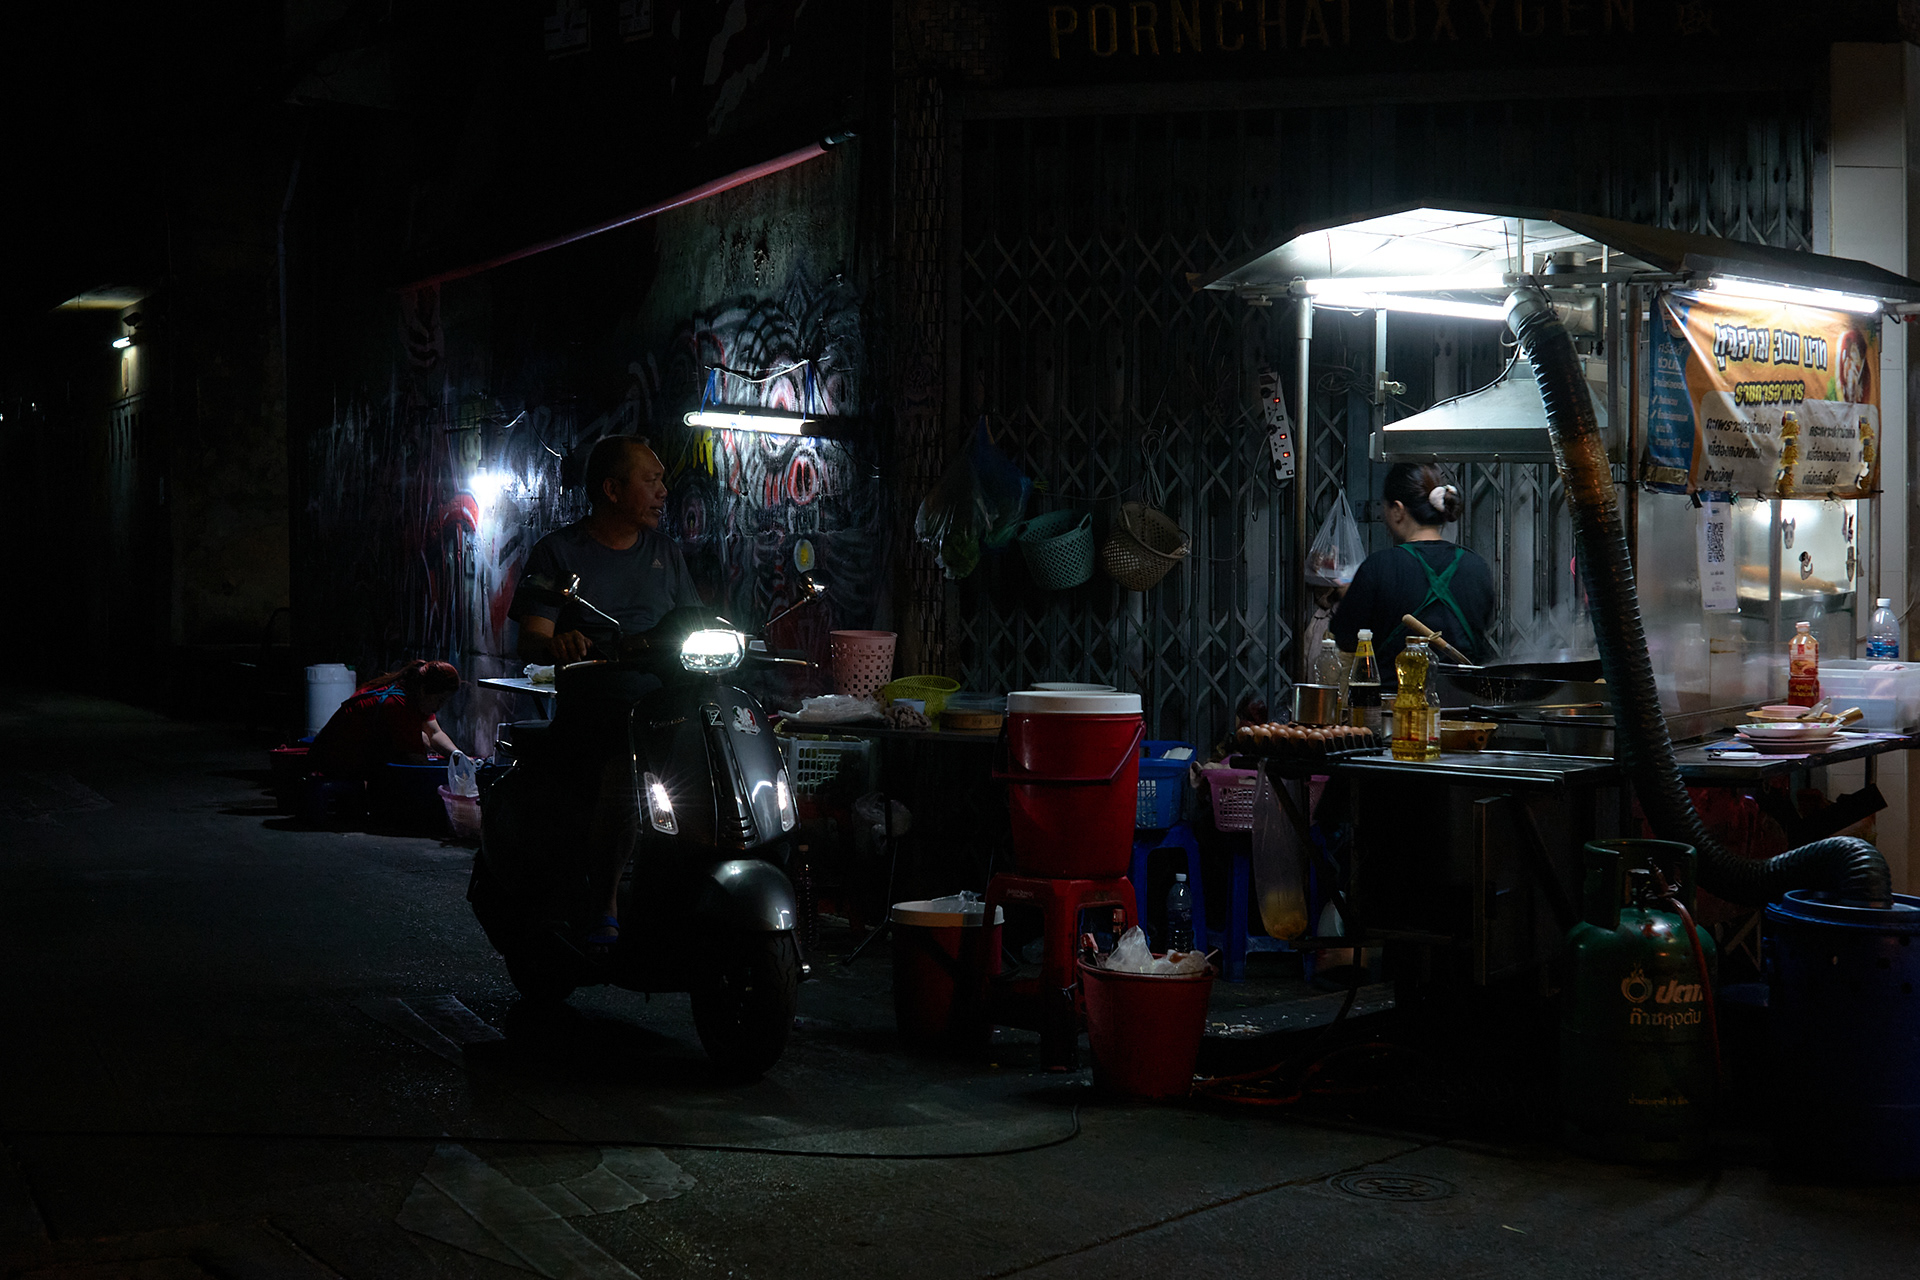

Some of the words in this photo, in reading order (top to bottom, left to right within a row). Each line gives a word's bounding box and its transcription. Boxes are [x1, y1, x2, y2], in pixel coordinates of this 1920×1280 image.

[1048, 0, 1351, 59] PORNCHAI
[1713, 322, 1770, 371] หูฉลาม
[1773, 329, 1800, 365] 300
[1803, 335, 1828, 371] บาท
[1735, 380, 1805, 406] รายการอาหาร
[1629, 1007, 1702, 1029] ก๊าซหุงต้ม
